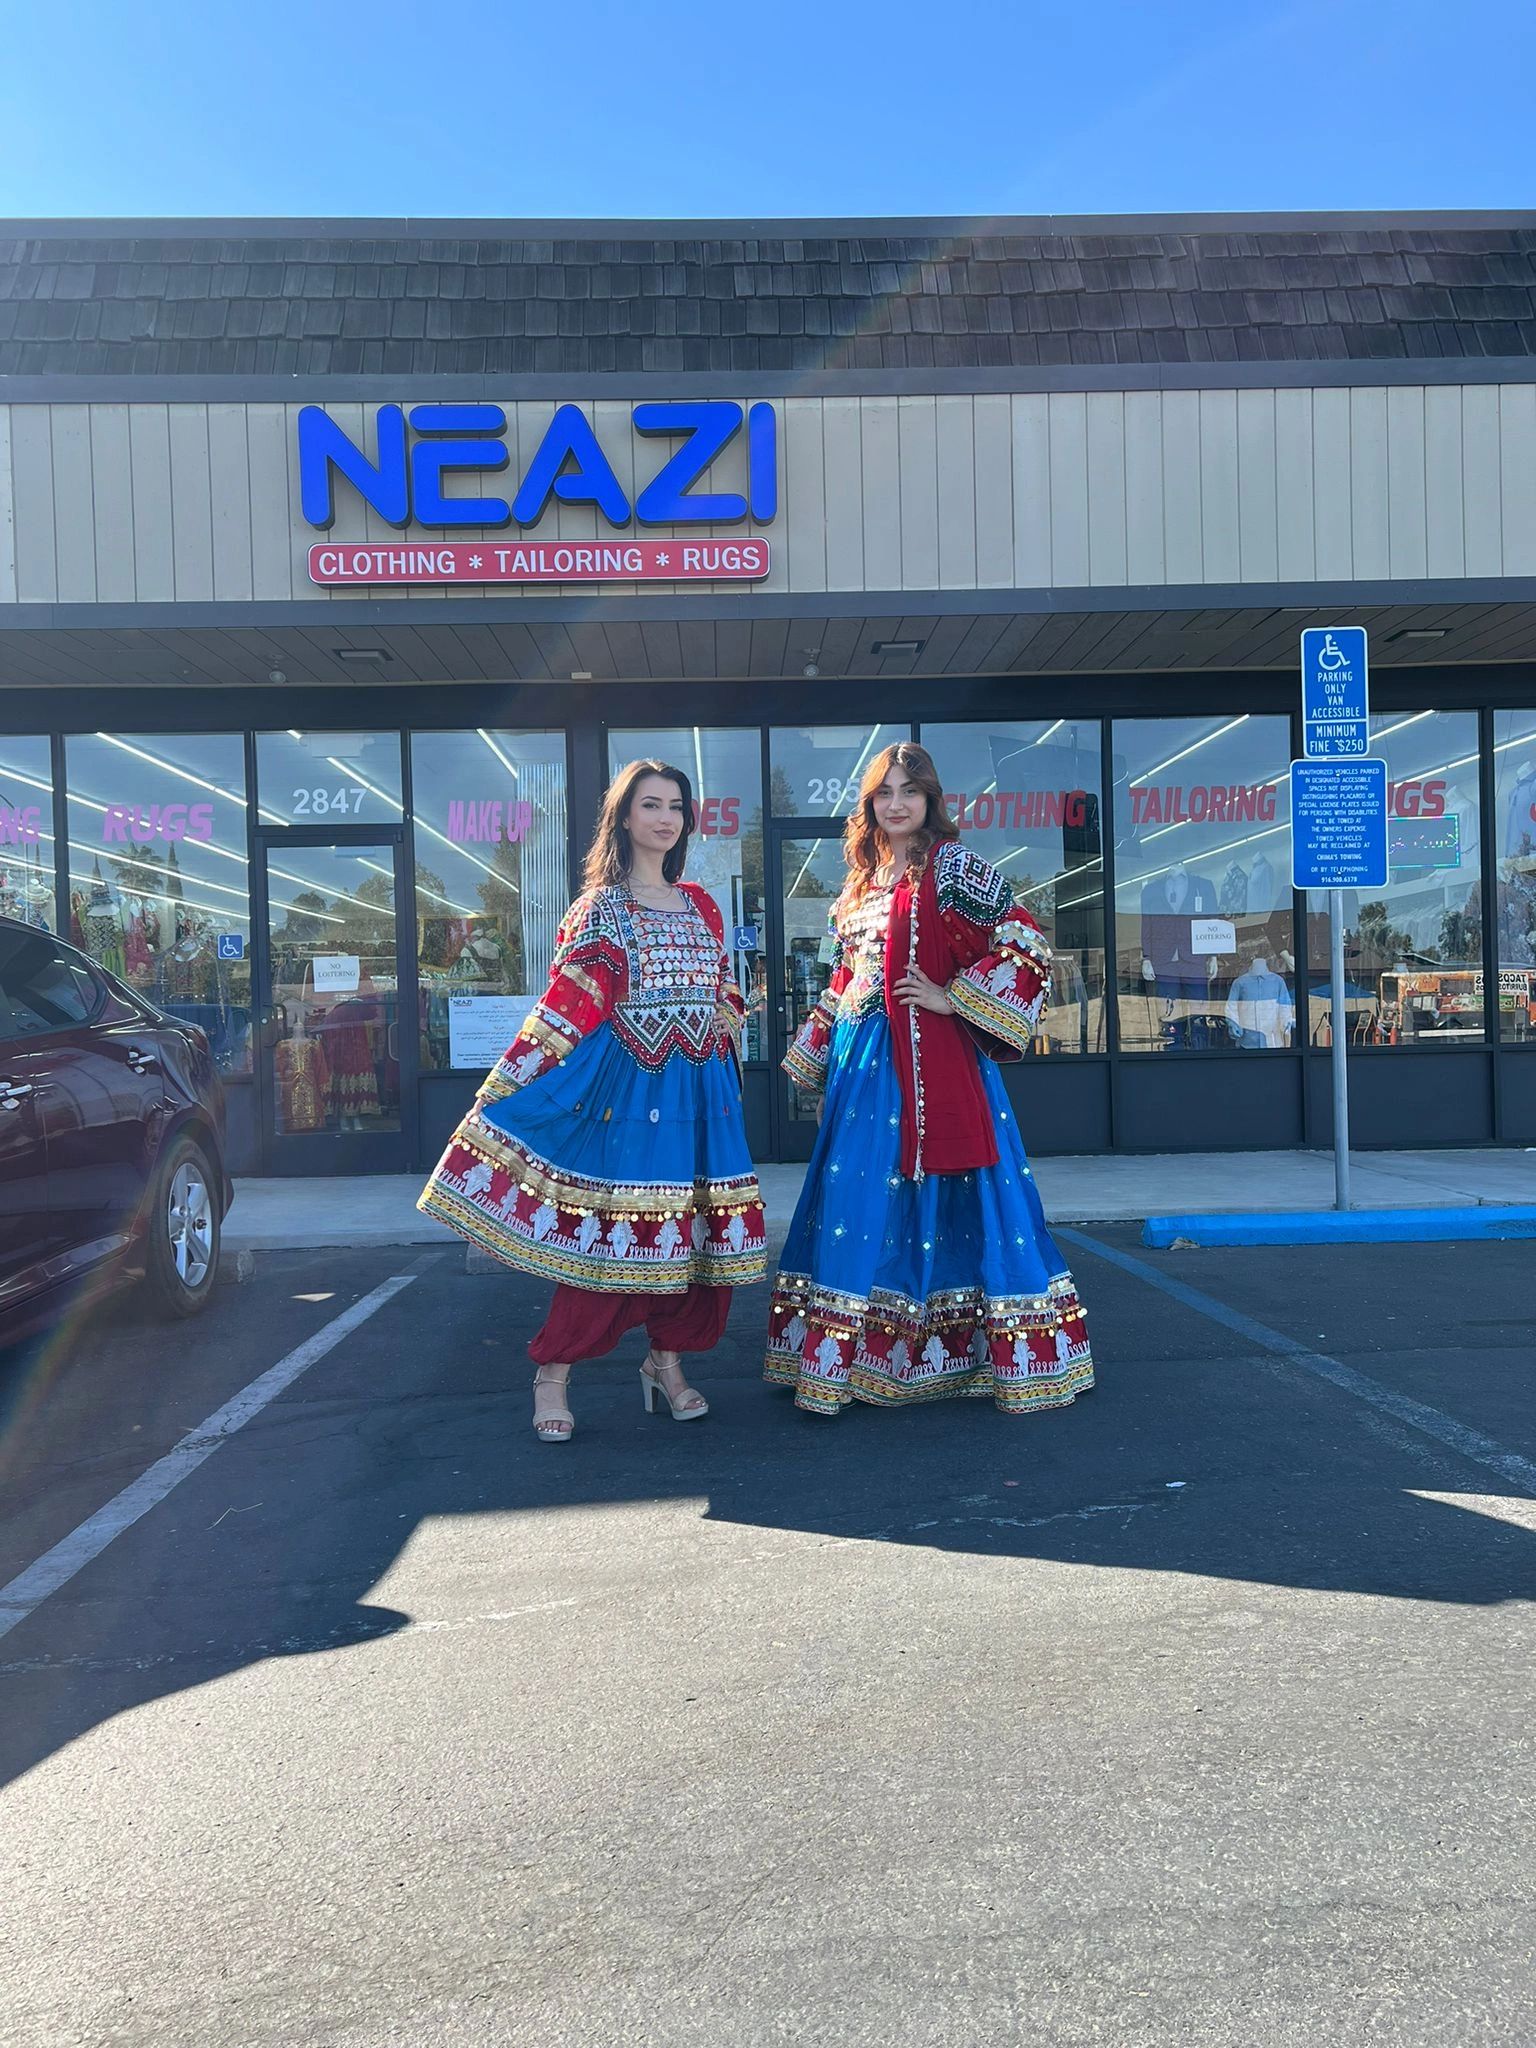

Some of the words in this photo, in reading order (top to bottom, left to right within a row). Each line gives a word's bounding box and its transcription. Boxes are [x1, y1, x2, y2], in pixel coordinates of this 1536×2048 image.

[298, 402, 777, 529] NEAZI
[319, 551, 456, 575] CLOTHING
[494, 548, 643, 573] TAILORING
[683, 547, 761, 571] RUGS
[1317, 671, 1353, 682] PARKING
[1324, 683, 1346, 694] ONLY
[1327, 695, 1344, 706] VAN
[1311, 706, 1360, 718] ACCESSIBLE
[1316, 724, 1357, 737] MINIMUM
[1310, 740, 1330, 753] FINE
[1337, 739, 1364, 752] $250
[807, 778, 860, 804] 285
[292, 788, 367, 814] 2847
[1129, 785, 1276, 824] TAILORING
[102, 803, 214, 843] RUGS
[447, 800, 502, 842] MAKE
[507, 800, 532, 842] UP
[1195, 933, 1232, 941] LOITERING
[318, 970, 356, 978] LOITERING
